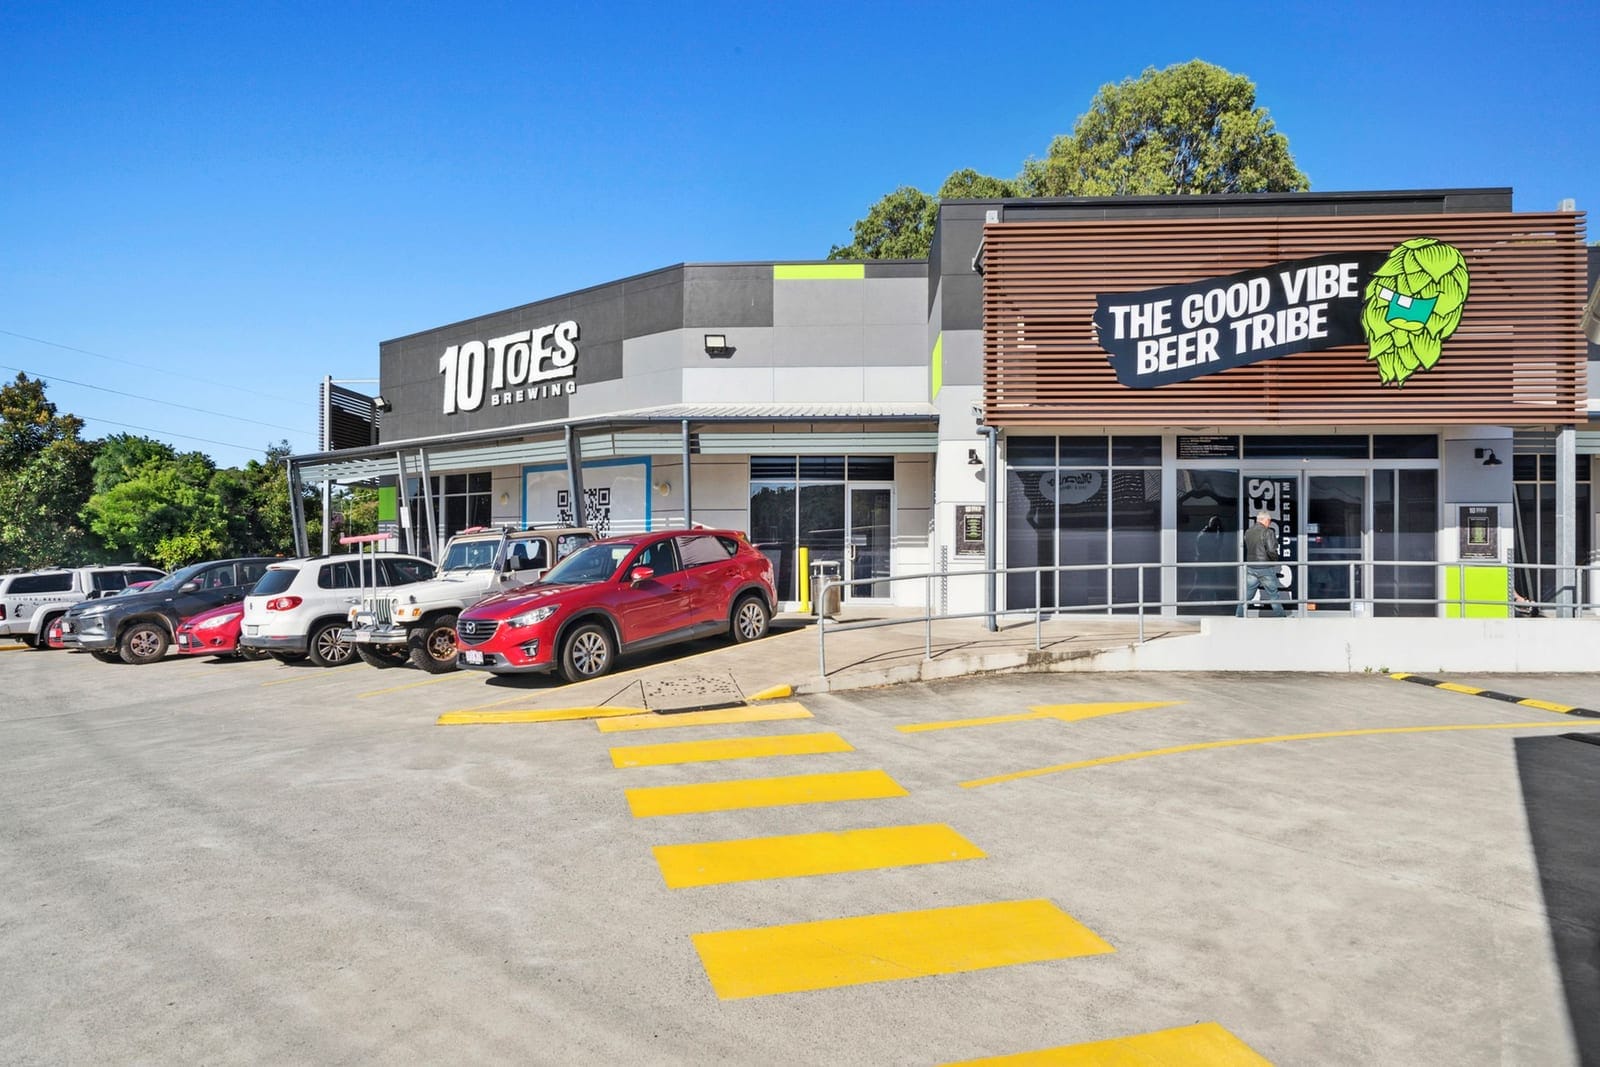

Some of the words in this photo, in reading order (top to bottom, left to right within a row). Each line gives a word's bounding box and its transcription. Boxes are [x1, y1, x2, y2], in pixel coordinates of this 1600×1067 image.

[1109, 299, 1172, 340] THE
[1181, 277, 1270, 329] GOOD
[1280, 262, 1358, 305] VIBE
[1136, 327, 1219, 375] BEER
[1230, 302, 1328, 355] TRIBE
[439, 340, 486, 415] 10
[491, 381, 576, 406] BREWING
[1248, 479, 1281, 556] ES
[1282, 481, 1291, 558] BUDERIM
